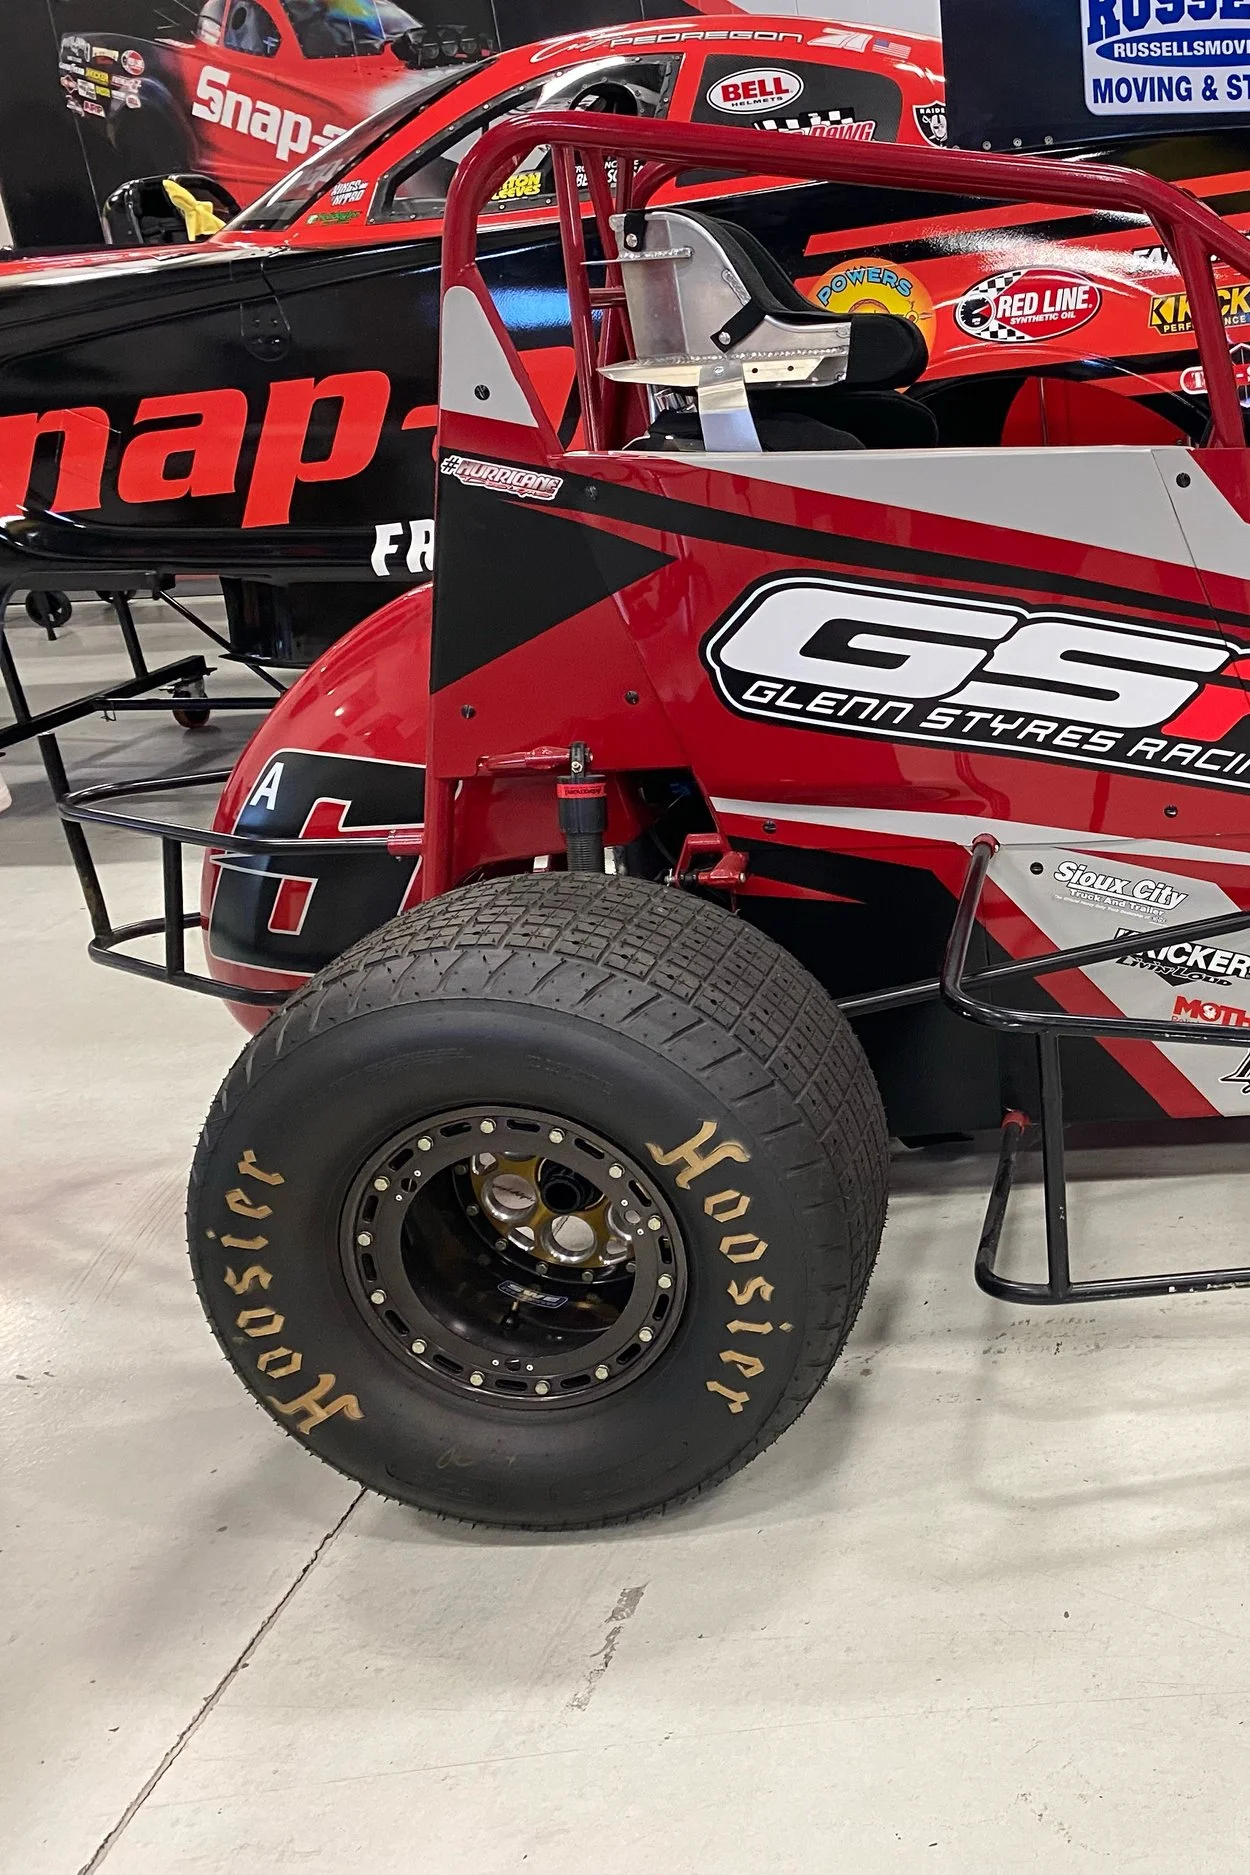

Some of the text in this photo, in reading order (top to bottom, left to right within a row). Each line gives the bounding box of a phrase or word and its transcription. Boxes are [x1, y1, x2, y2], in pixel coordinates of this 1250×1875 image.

[721, 77, 790, 101] BELL
[731, 95, 784, 107] HELMETS
[1092, 75, 1193, 104] MOVING
[1201, 75, 1219, 101] &
[816, 265, 914, 305] POWERS
[997, 292, 1041, 319] RED
[1009, 311, 1076, 325] SYNTHETIC OIL
[742, 680, 923, 725] GLENN
[918, 703, 1126, 750] STYRES
[249, 761, 285, 811] A
[1053, 861, 1189, 910] Sioux City
[1069, 888, 1166, 917] Truck And Trailer
[645, 1119, 794, 1415] Hoosier
[206, 1149, 366, 1435] Hoosier
